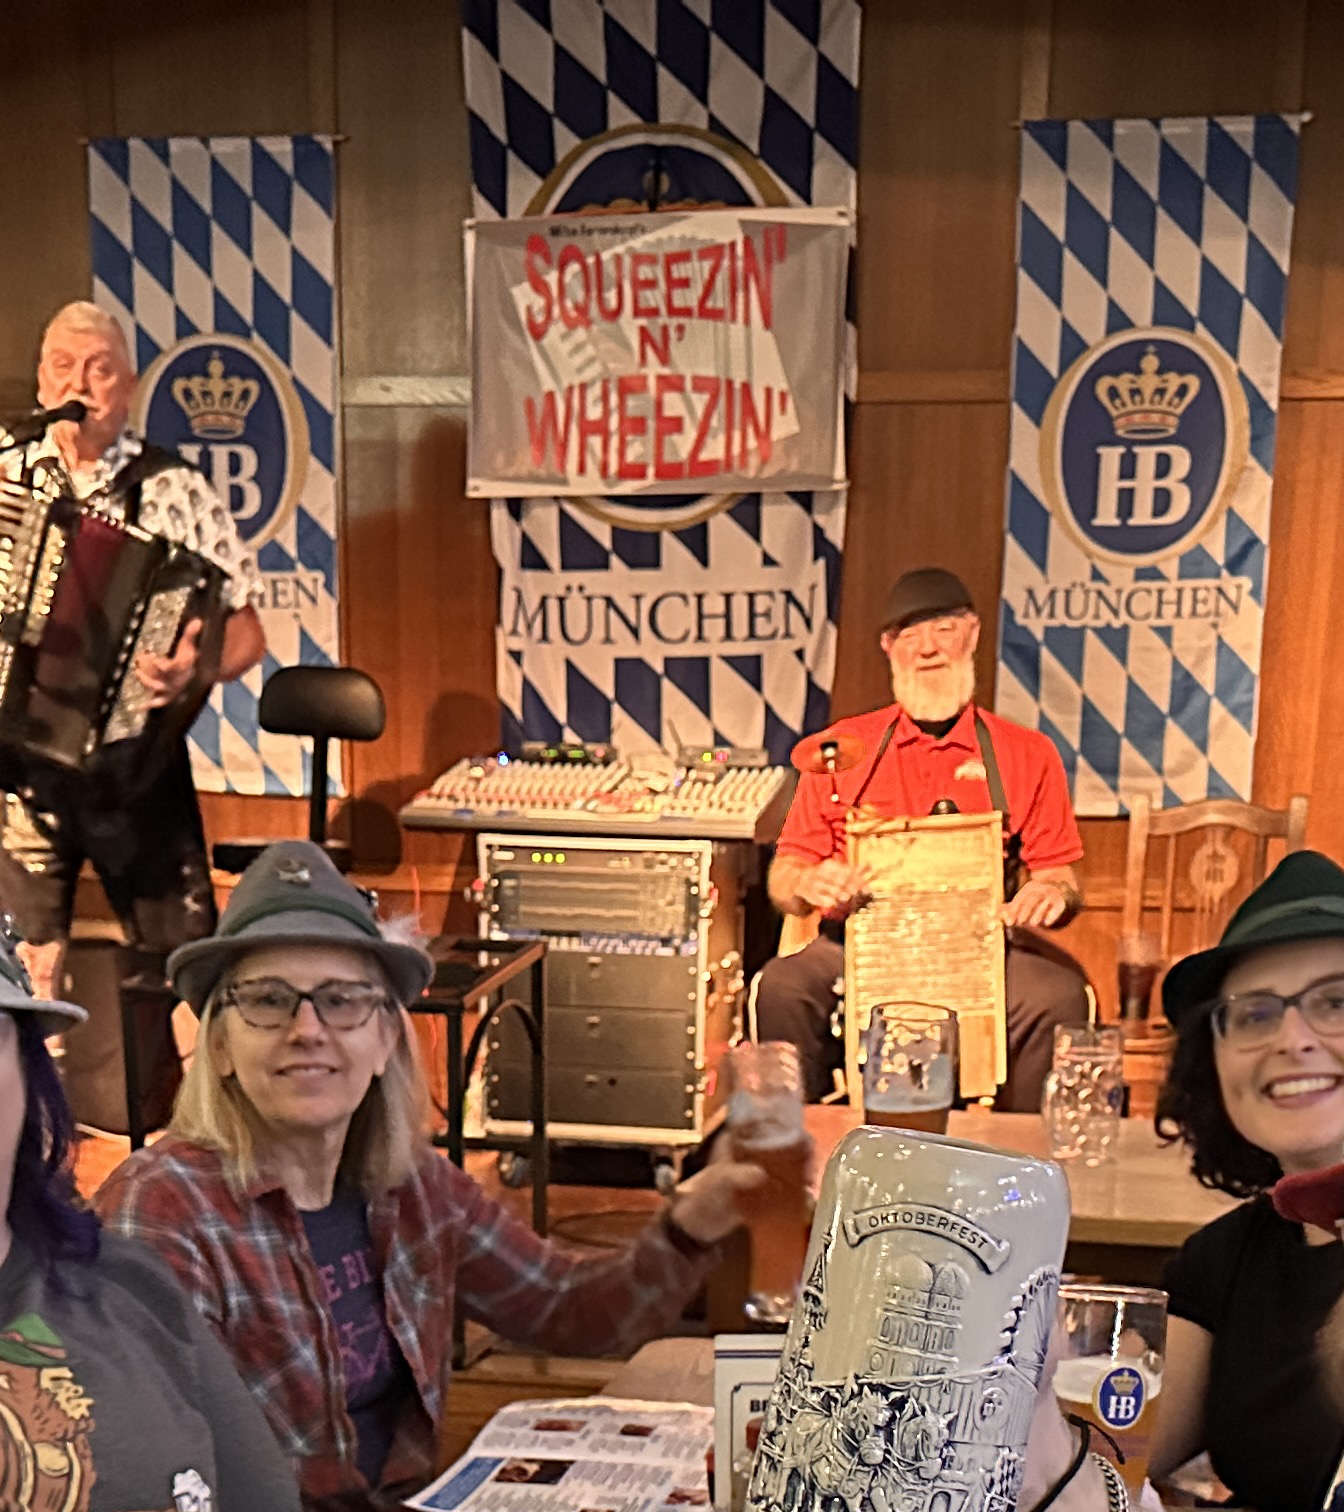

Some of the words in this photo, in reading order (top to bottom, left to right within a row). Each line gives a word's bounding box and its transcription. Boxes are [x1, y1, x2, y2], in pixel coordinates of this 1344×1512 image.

[524, 224, 787, 343] SQUEEZIN'
[524, 374, 789, 481] WHEEZIN'
[1091, 443, 1192, 527] HB
[508, 582, 818, 646] MÜNCHEN
[1021, 580, 1245, 623] MÜNCHEN
[868, 1210, 989, 1250] OKTOBERFEST
[1107, 1394, 1136, 1420] HB
